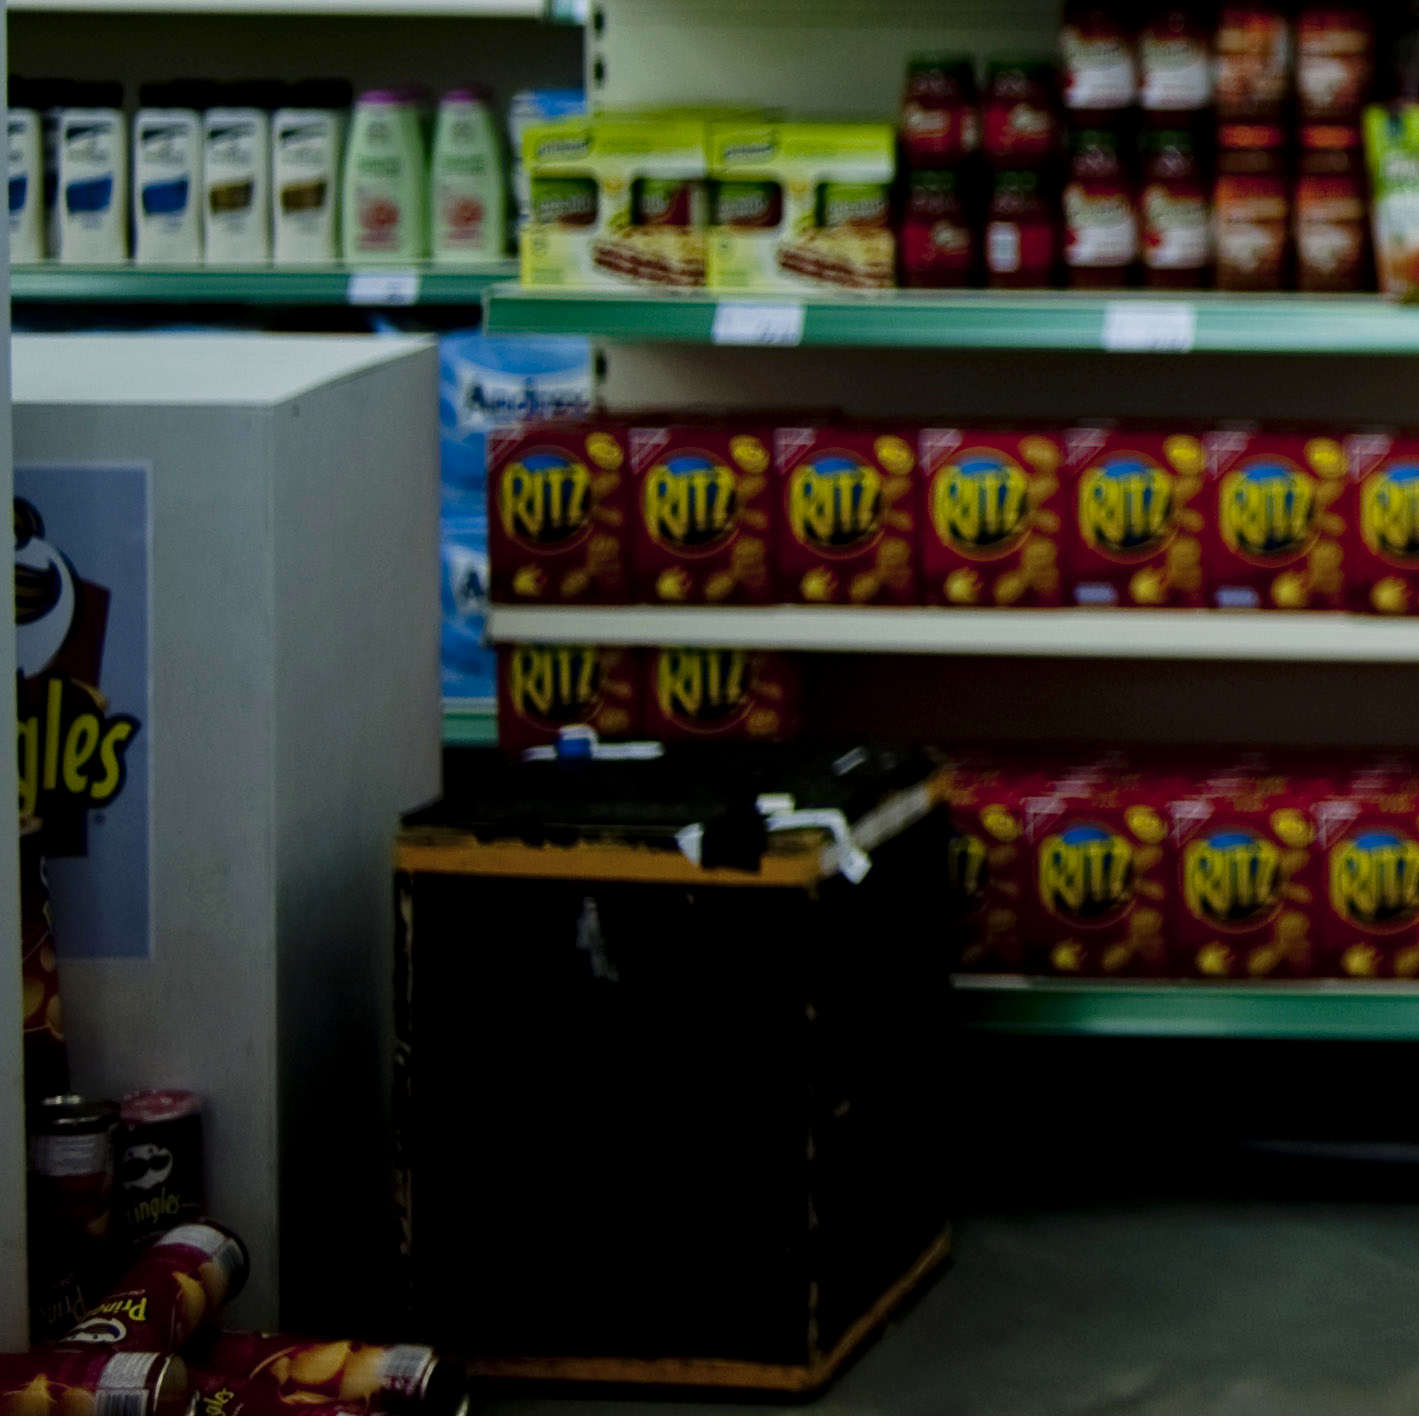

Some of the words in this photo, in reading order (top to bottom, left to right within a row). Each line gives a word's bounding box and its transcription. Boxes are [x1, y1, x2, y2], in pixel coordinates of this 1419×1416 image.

[501, 462, 593, 538] RITZ
[643, 464, 738, 540] RITZ
[788, 463, 883, 540] RITZ
[932, 463, 1030, 545] RITZ
[1077, 465, 1174, 552] RITZ
[1218, 468, 1315, 555] RITZ
[1039, 833, 1133, 914] RITZ
[1182, 838, 1279, 918] RITZ
